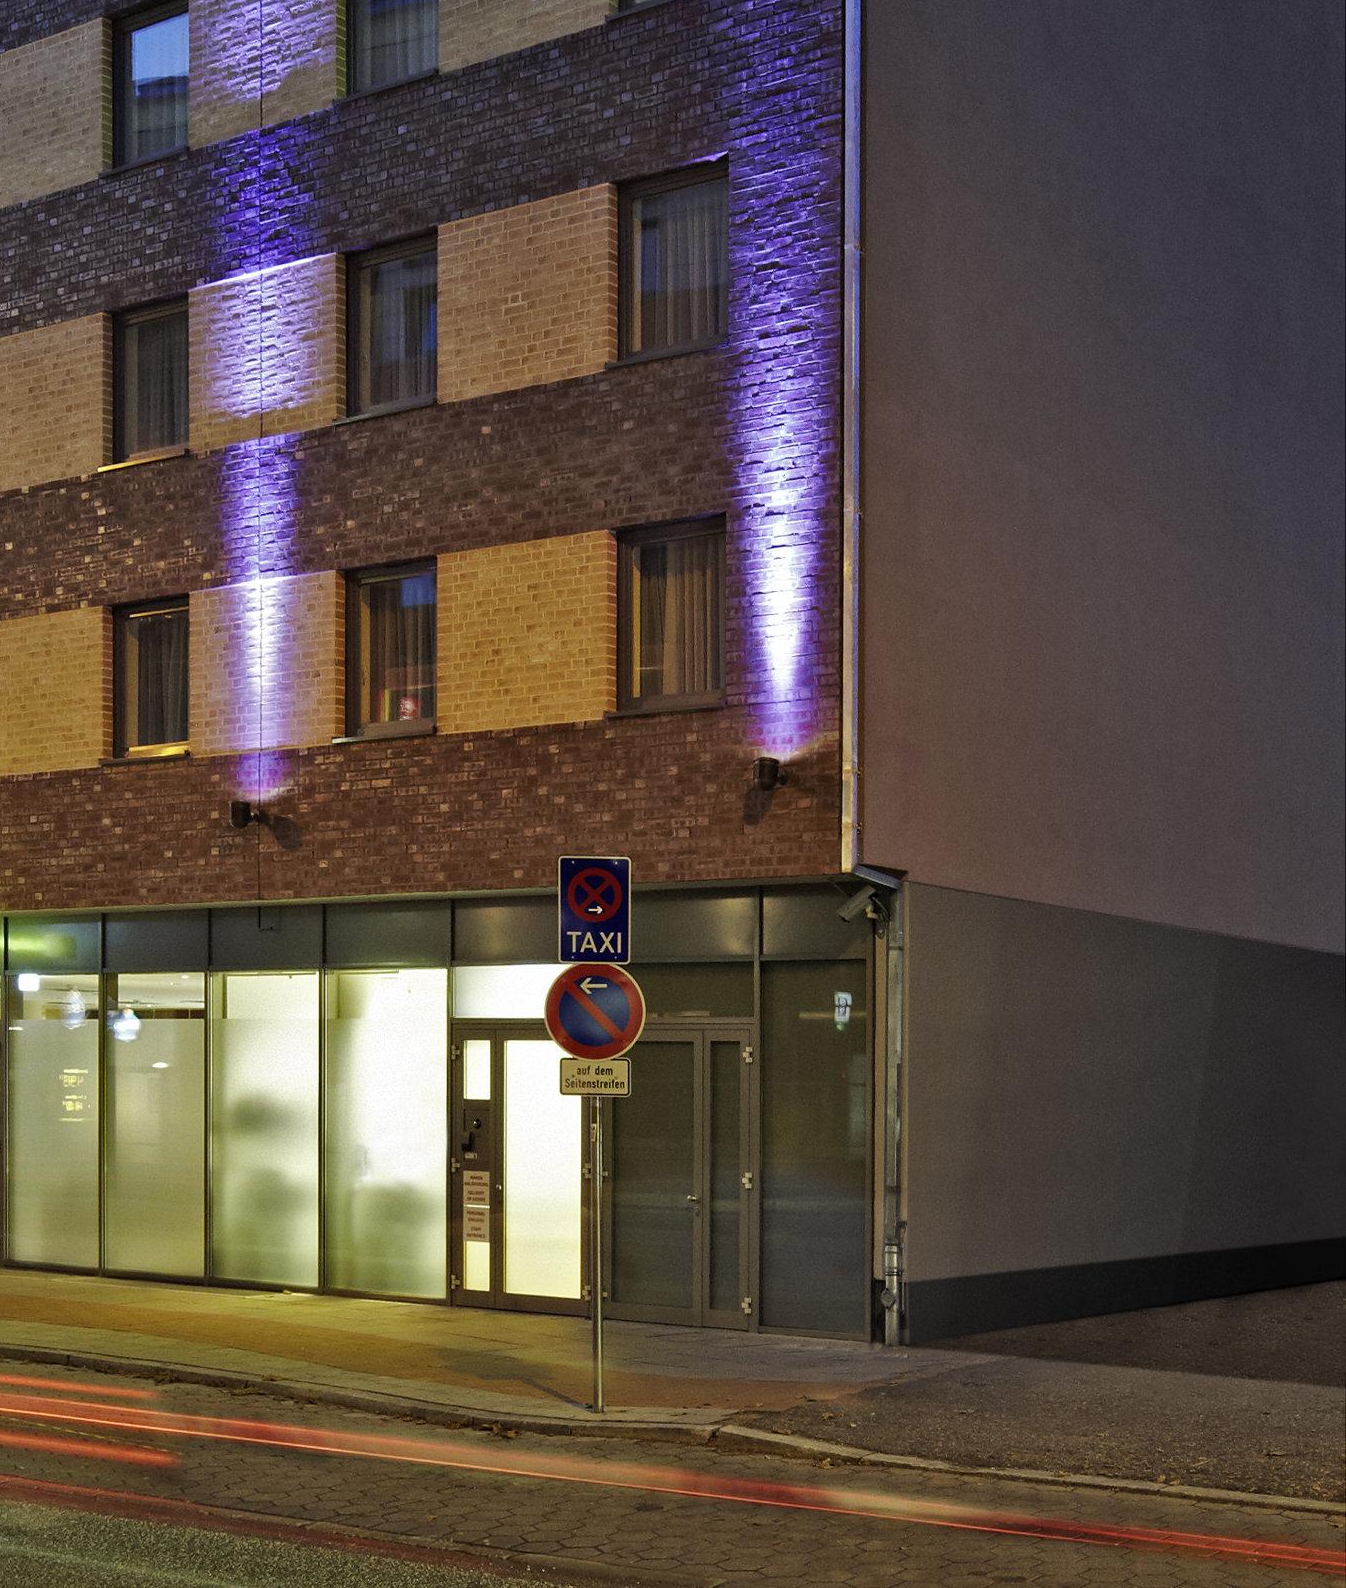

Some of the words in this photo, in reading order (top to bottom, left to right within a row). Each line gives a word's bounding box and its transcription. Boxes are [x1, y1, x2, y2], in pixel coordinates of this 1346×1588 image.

[566, 931, 622, 954] TAXI
[576, 1065, 591, 1076] auf
[594, 1065, 614, 1076] dem
[564, 1077, 626, 1089] Seitenstreifen
